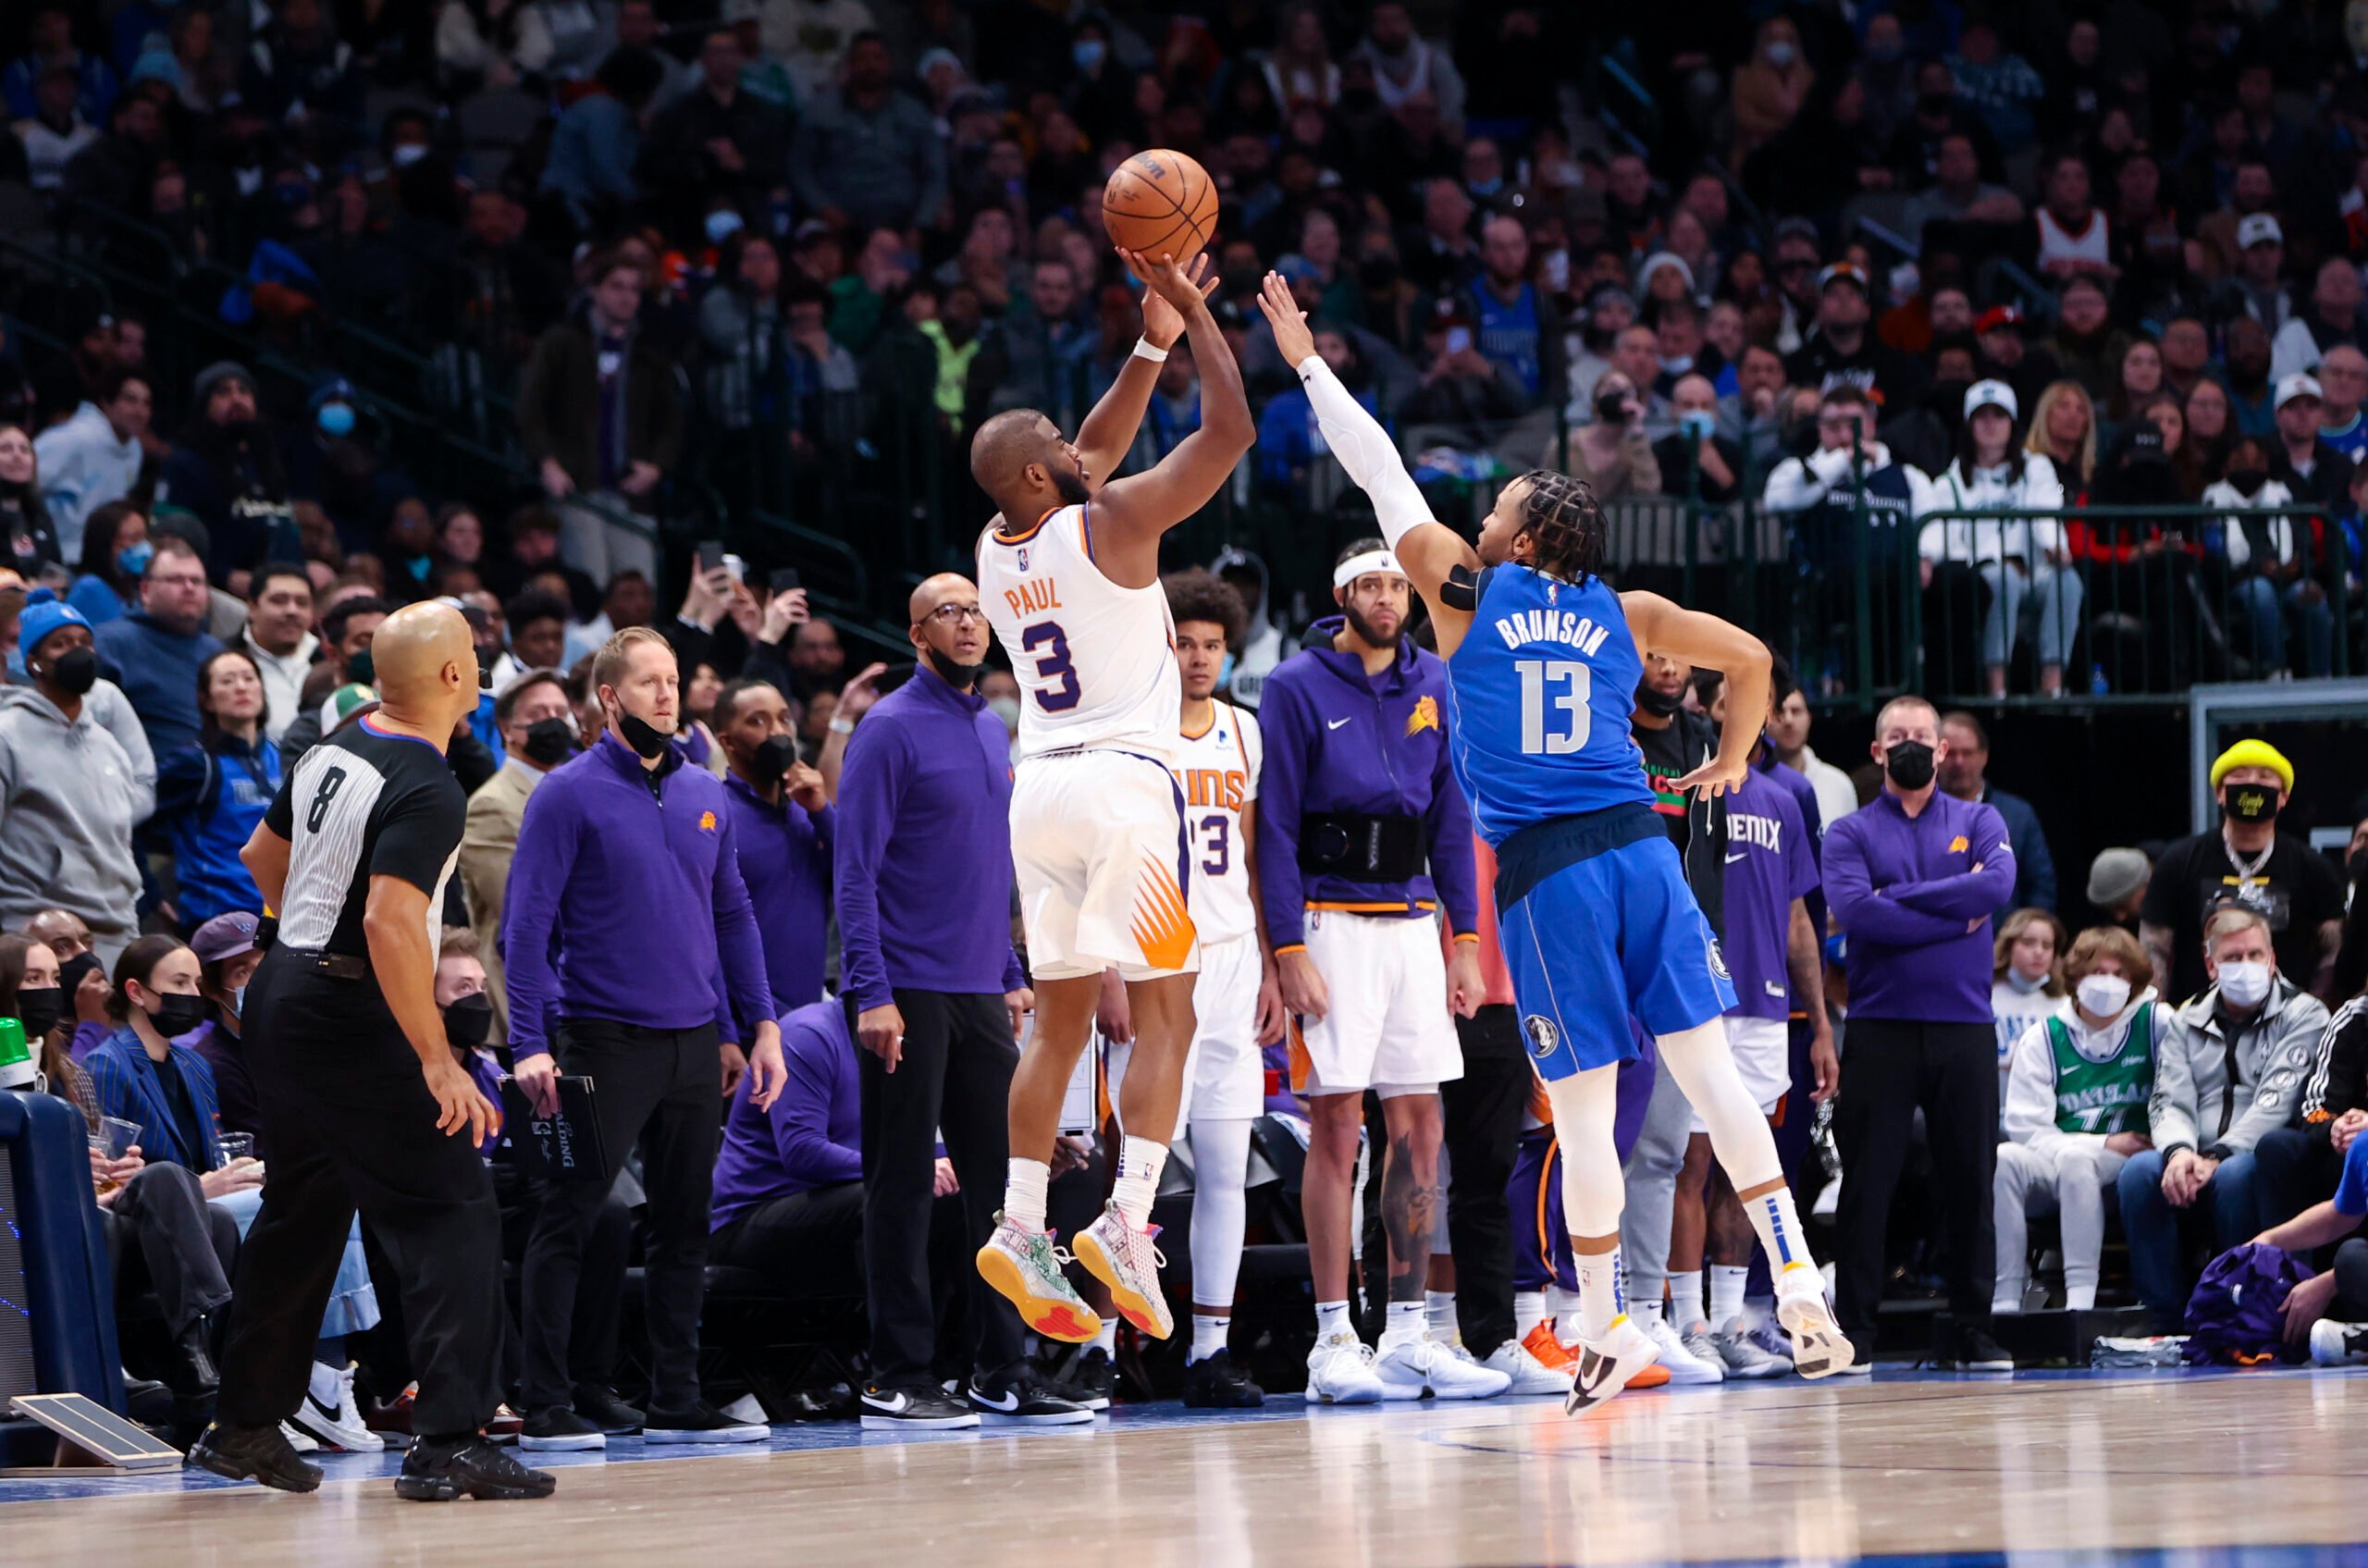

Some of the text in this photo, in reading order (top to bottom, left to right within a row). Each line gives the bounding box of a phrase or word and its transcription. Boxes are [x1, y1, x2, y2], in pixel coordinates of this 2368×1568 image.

[1004, 577, 1062, 620] PAUL
[1495, 610, 1610, 657] BRUNSON
[1022, 621, 1081, 713] 3
[1515, 661, 1591, 754] 13
[307, 766, 347, 834] 8
[1170, 769, 1245, 814] UNS
[1190, 815, 1229, 876] 3
[1726, 813, 1782, 855] ENIX
[555, 1112, 575, 1167] ALDING
